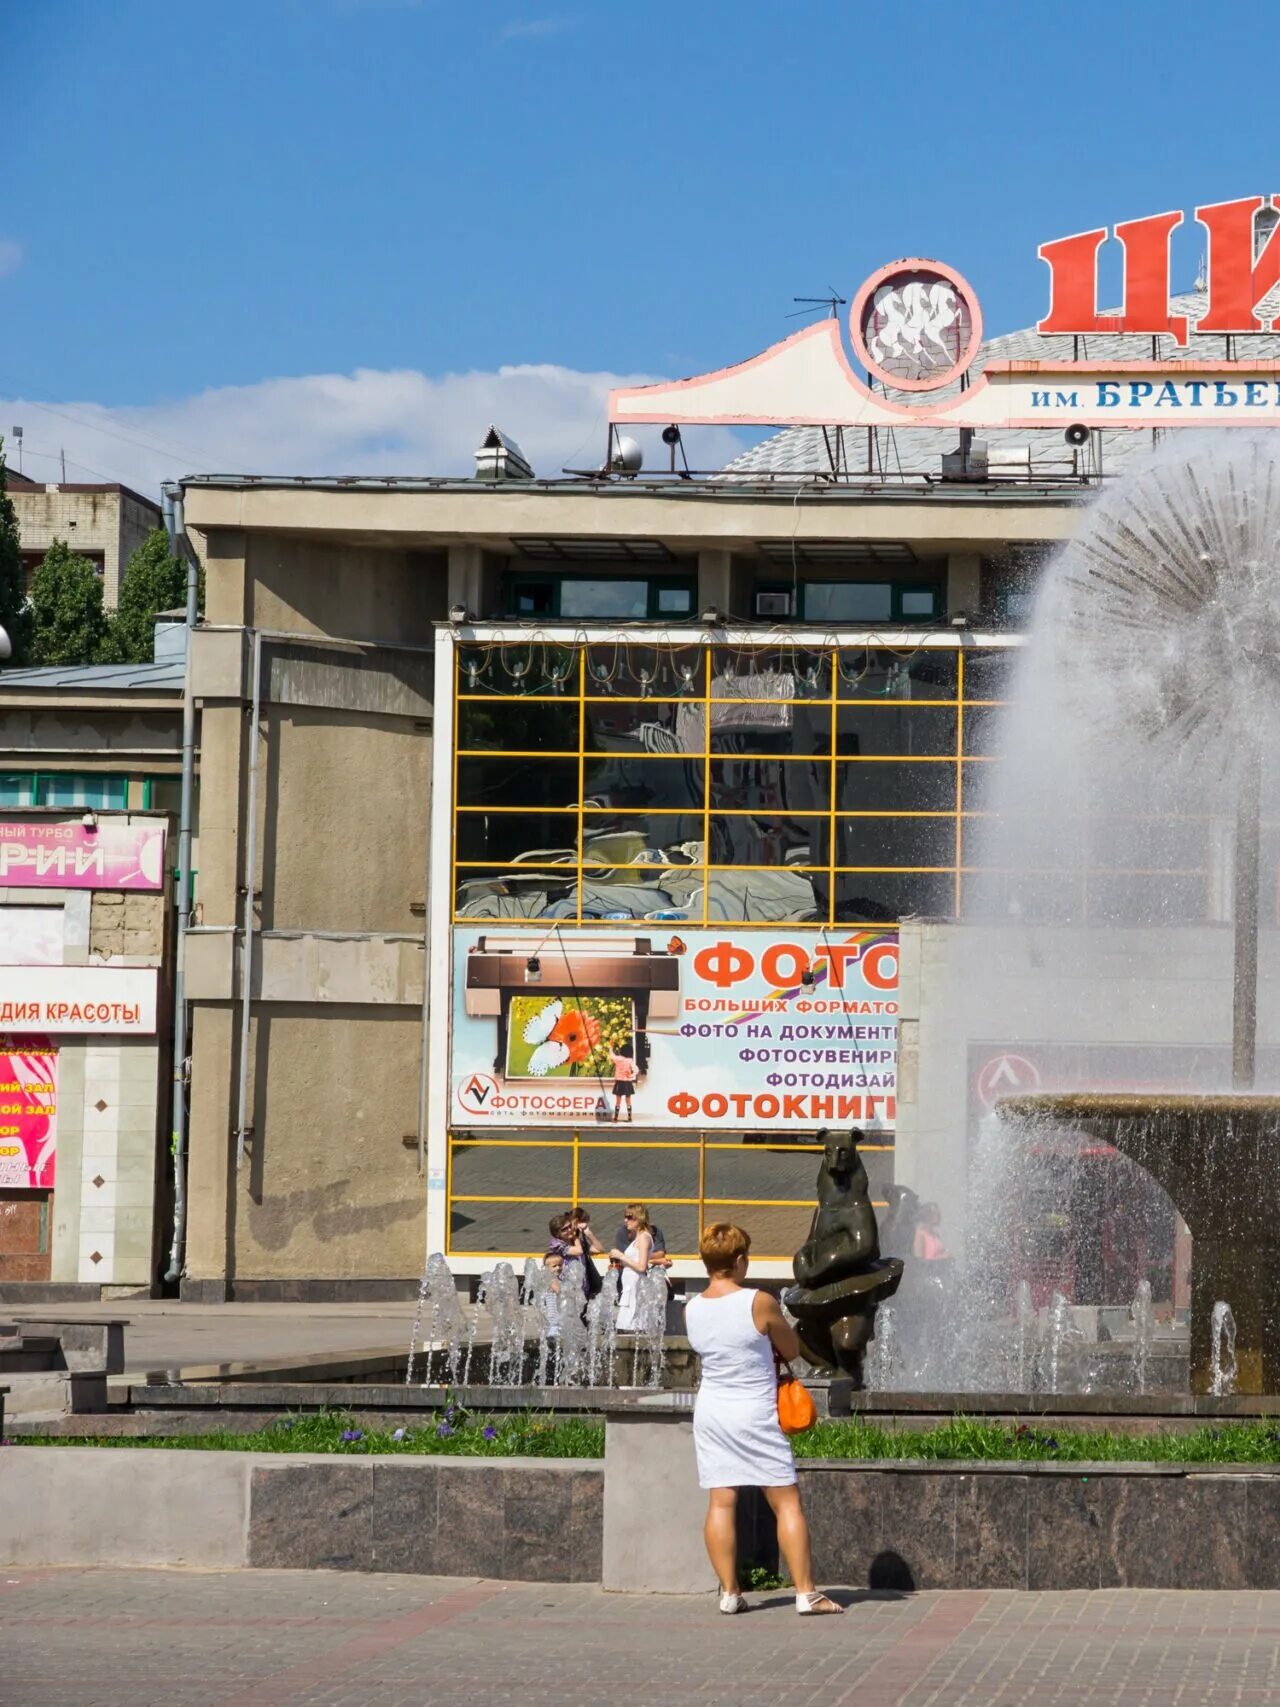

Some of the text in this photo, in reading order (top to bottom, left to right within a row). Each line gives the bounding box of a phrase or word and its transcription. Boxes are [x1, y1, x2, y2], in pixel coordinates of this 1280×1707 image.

[30, 827, 73, 839] ТУРБО
[693, 941, 899, 988] ФОТО
[0, 1003, 140, 1021] ДИЯ КРАСОТЫ
[684, 998, 898, 1014] БОЛЬШИХ ФОРМАТО
[680, 1023, 739, 1038] ФОТО
[747, 1025, 773, 1038] НА
[25, 1083, 54, 1093] ЗАЛ
[766, 1072, 895, 1089] ФОТОДИЗАЙ
[26, 1105, 56, 1115] ЗАЛ
[490, 1096, 607, 1109] ФОТОСФЕРА
